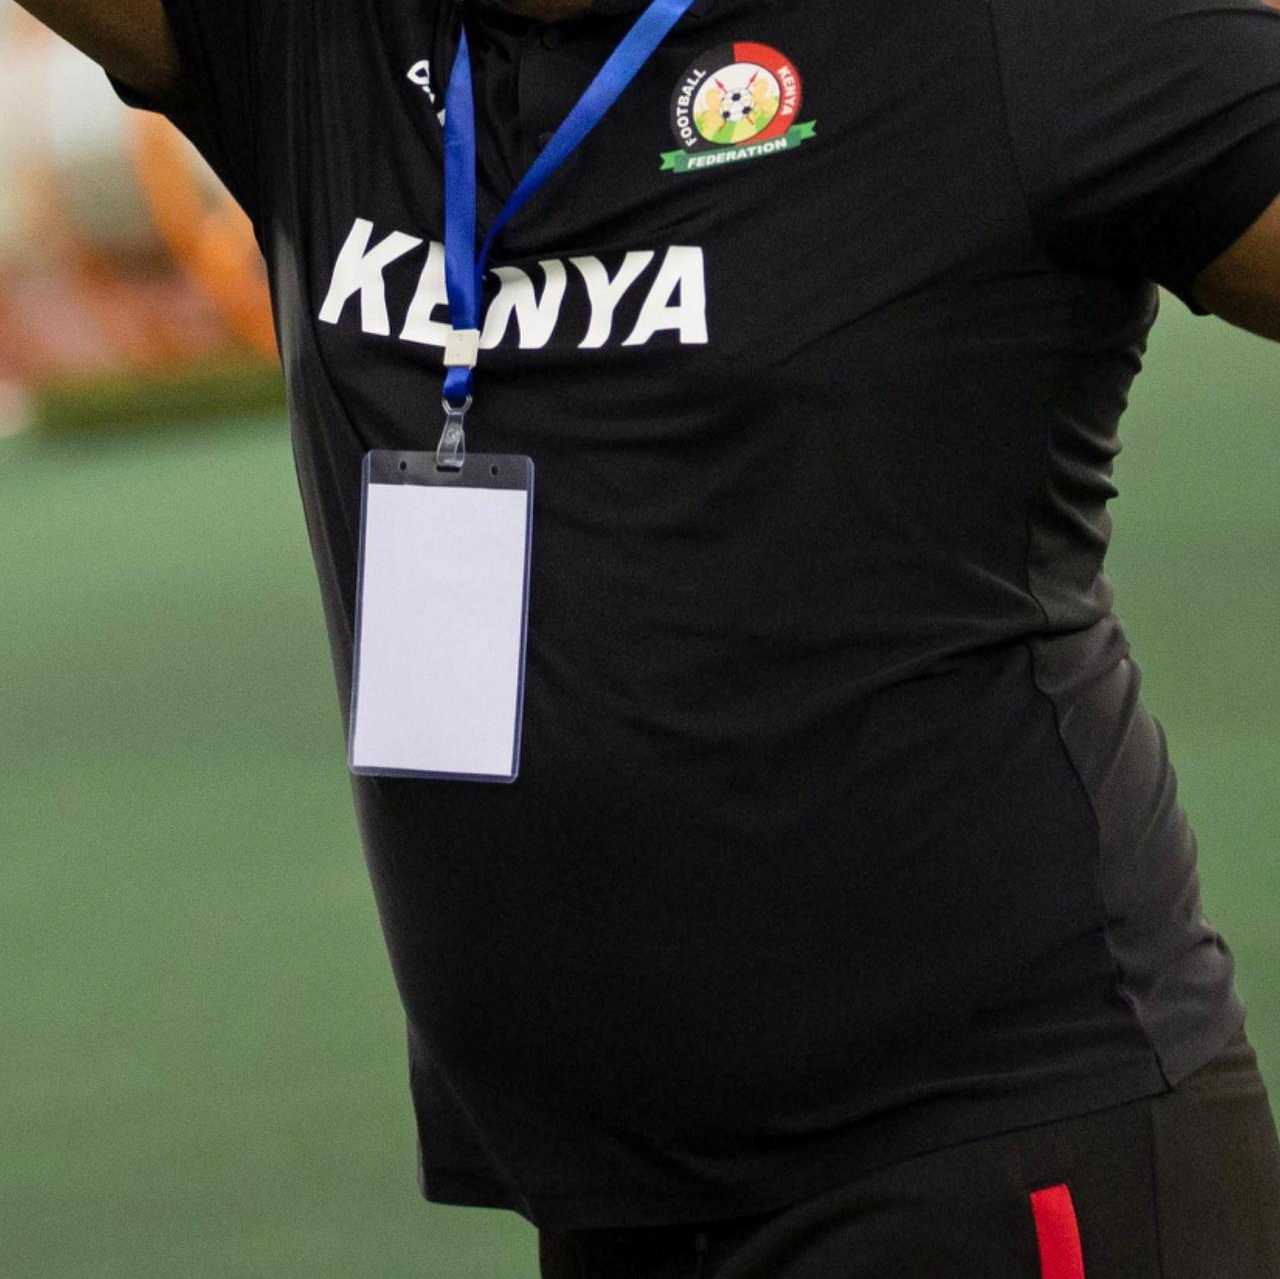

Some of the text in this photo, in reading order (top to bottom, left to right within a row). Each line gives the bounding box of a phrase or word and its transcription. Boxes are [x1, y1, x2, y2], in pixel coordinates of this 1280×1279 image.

[676, 68, 707, 146] FOOTBALL
[778, 66, 797, 116] KENYA
[687, 137, 787, 169] FEDERATION
